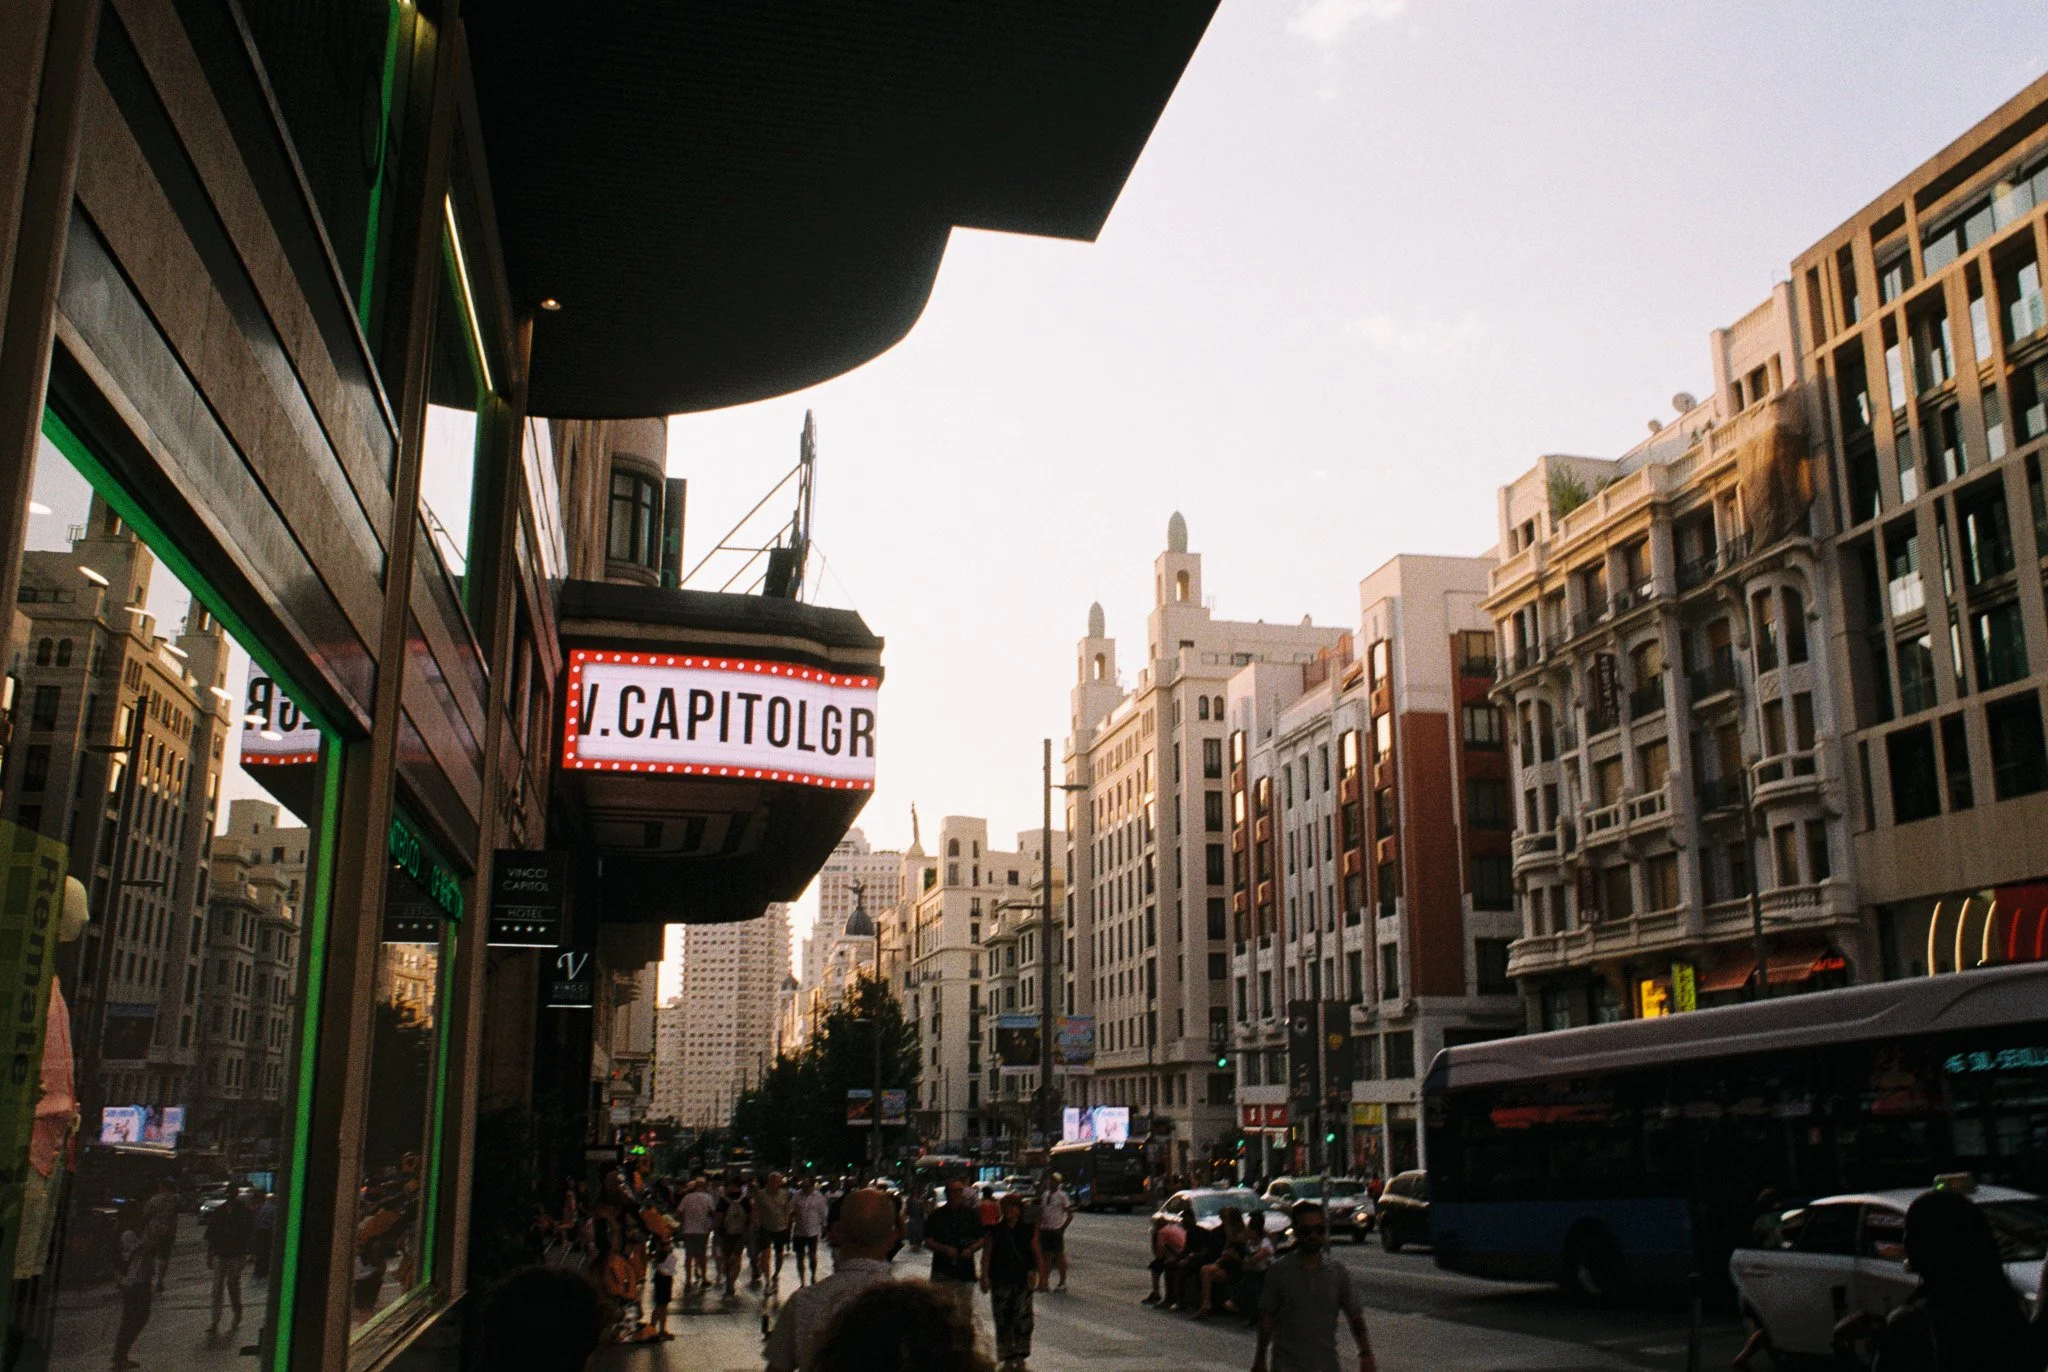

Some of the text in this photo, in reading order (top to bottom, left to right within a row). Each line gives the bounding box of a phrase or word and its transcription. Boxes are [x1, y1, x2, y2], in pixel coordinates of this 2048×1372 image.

[508, 868, 548, 879] VINCCI
[502, 880, 549, 892] CAPITOL
[508, 908, 543, 918] HOTEL
[556, 951, 589, 983] V
